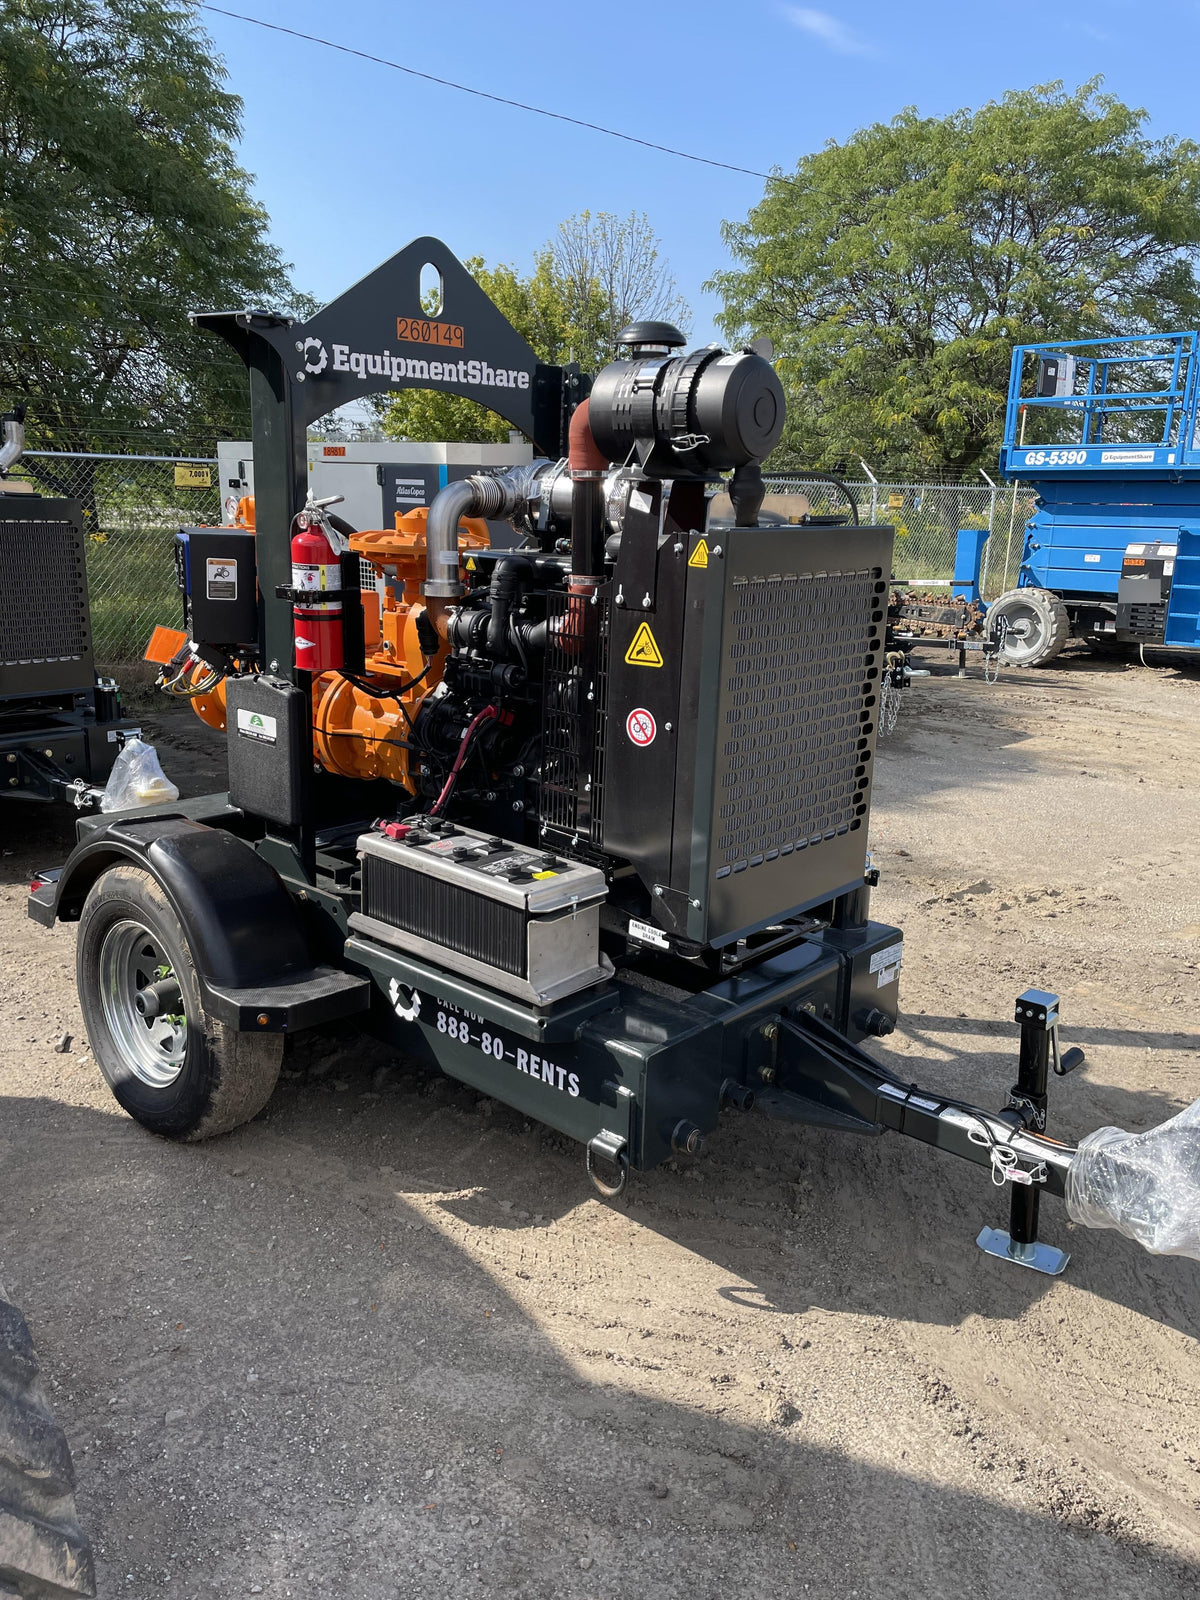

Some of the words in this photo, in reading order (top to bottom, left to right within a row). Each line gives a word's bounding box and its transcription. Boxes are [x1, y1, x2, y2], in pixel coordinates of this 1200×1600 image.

[398, 318, 463, 347] 260149
[332, 343, 530, 389] EquipmentShare
[1025, 450, 1087, 465] GS-5390
[1109, 454, 1153, 462] EquipmentShare
[396, 486, 410, 495] Atlas
[411, 486, 425, 497] Copco
[631, 922, 647, 932] ENGINE
[437, 997, 460, 1013] CALL
[436, 1011, 580, 1097] 888-80-RENTS
